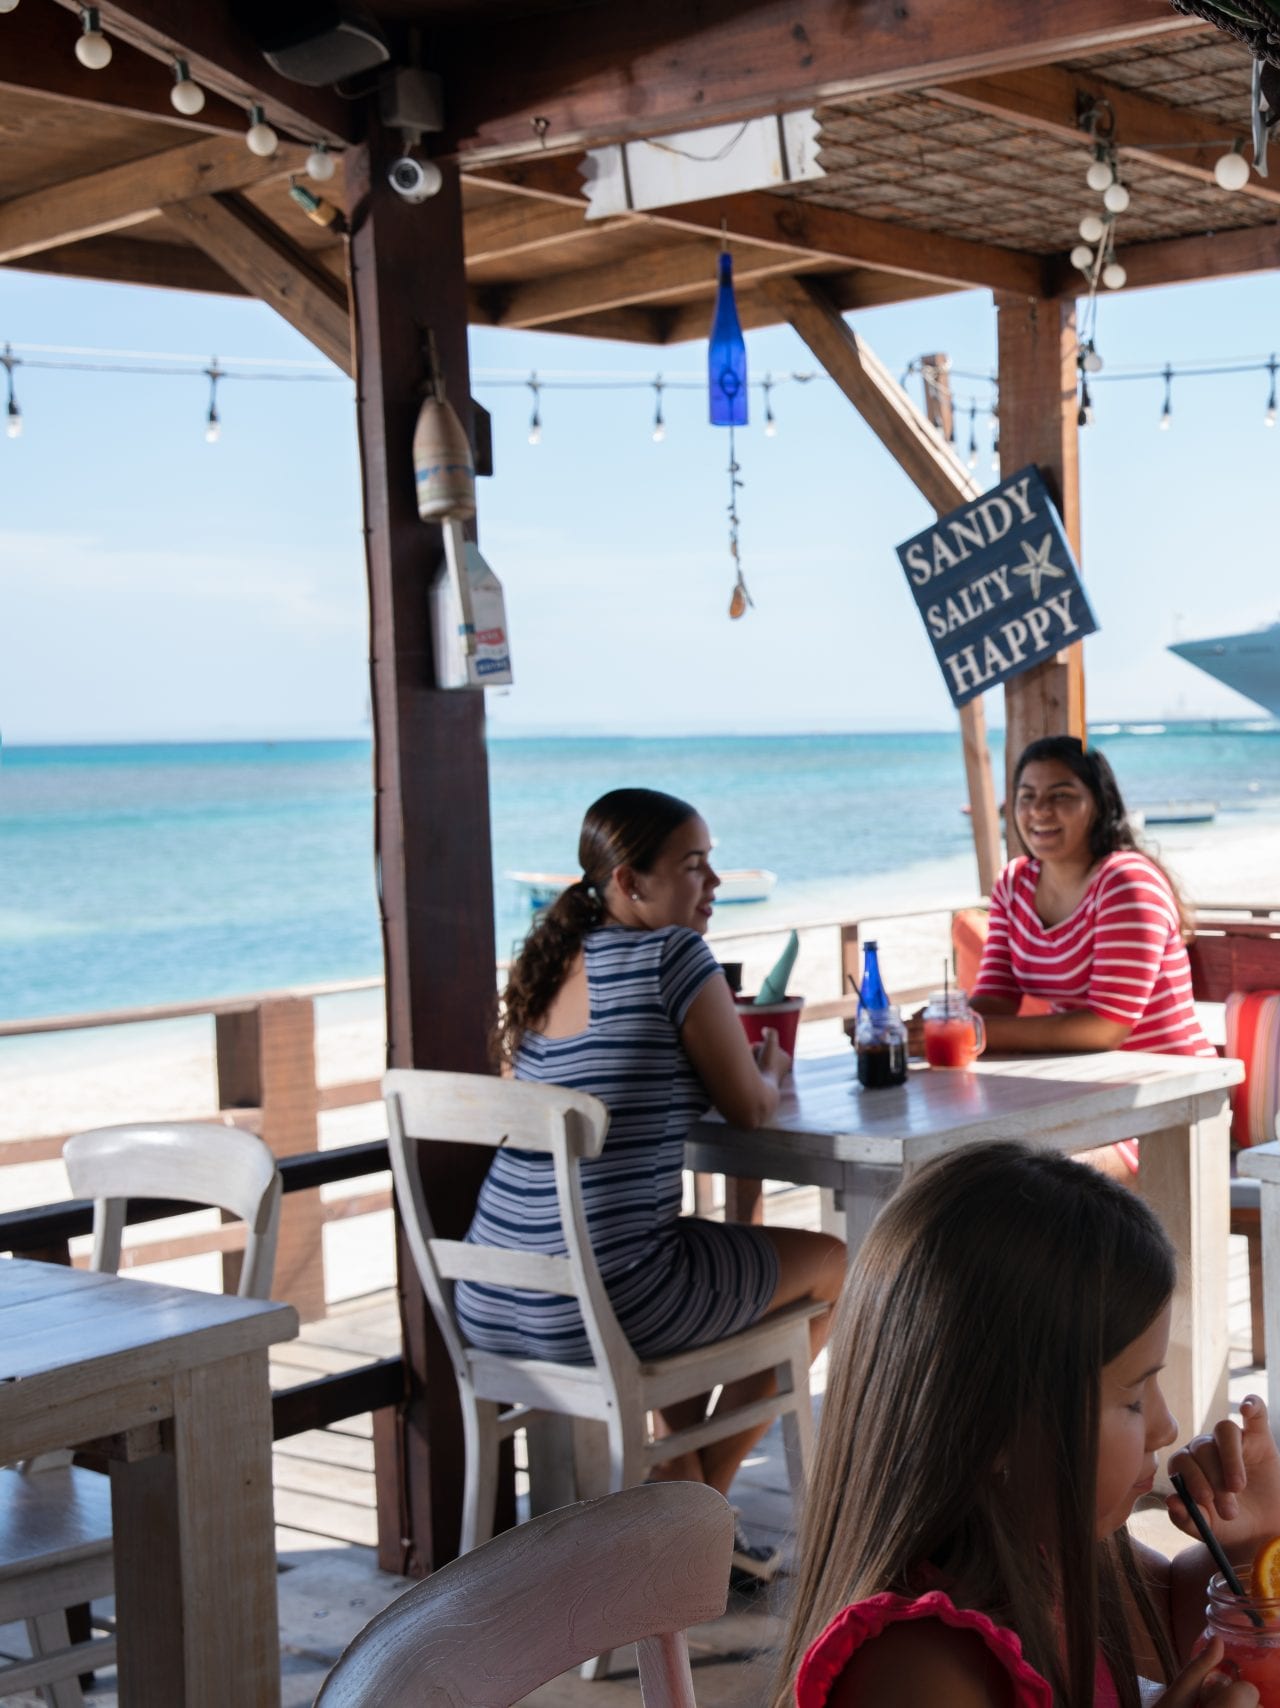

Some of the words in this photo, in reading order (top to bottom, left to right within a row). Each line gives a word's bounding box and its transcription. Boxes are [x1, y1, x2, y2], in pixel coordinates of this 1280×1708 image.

[906, 477, 1037, 585] SANDY
[927, 565, 1014, 639] SALTY
[944, 589, 1078, 695] HAPPY
